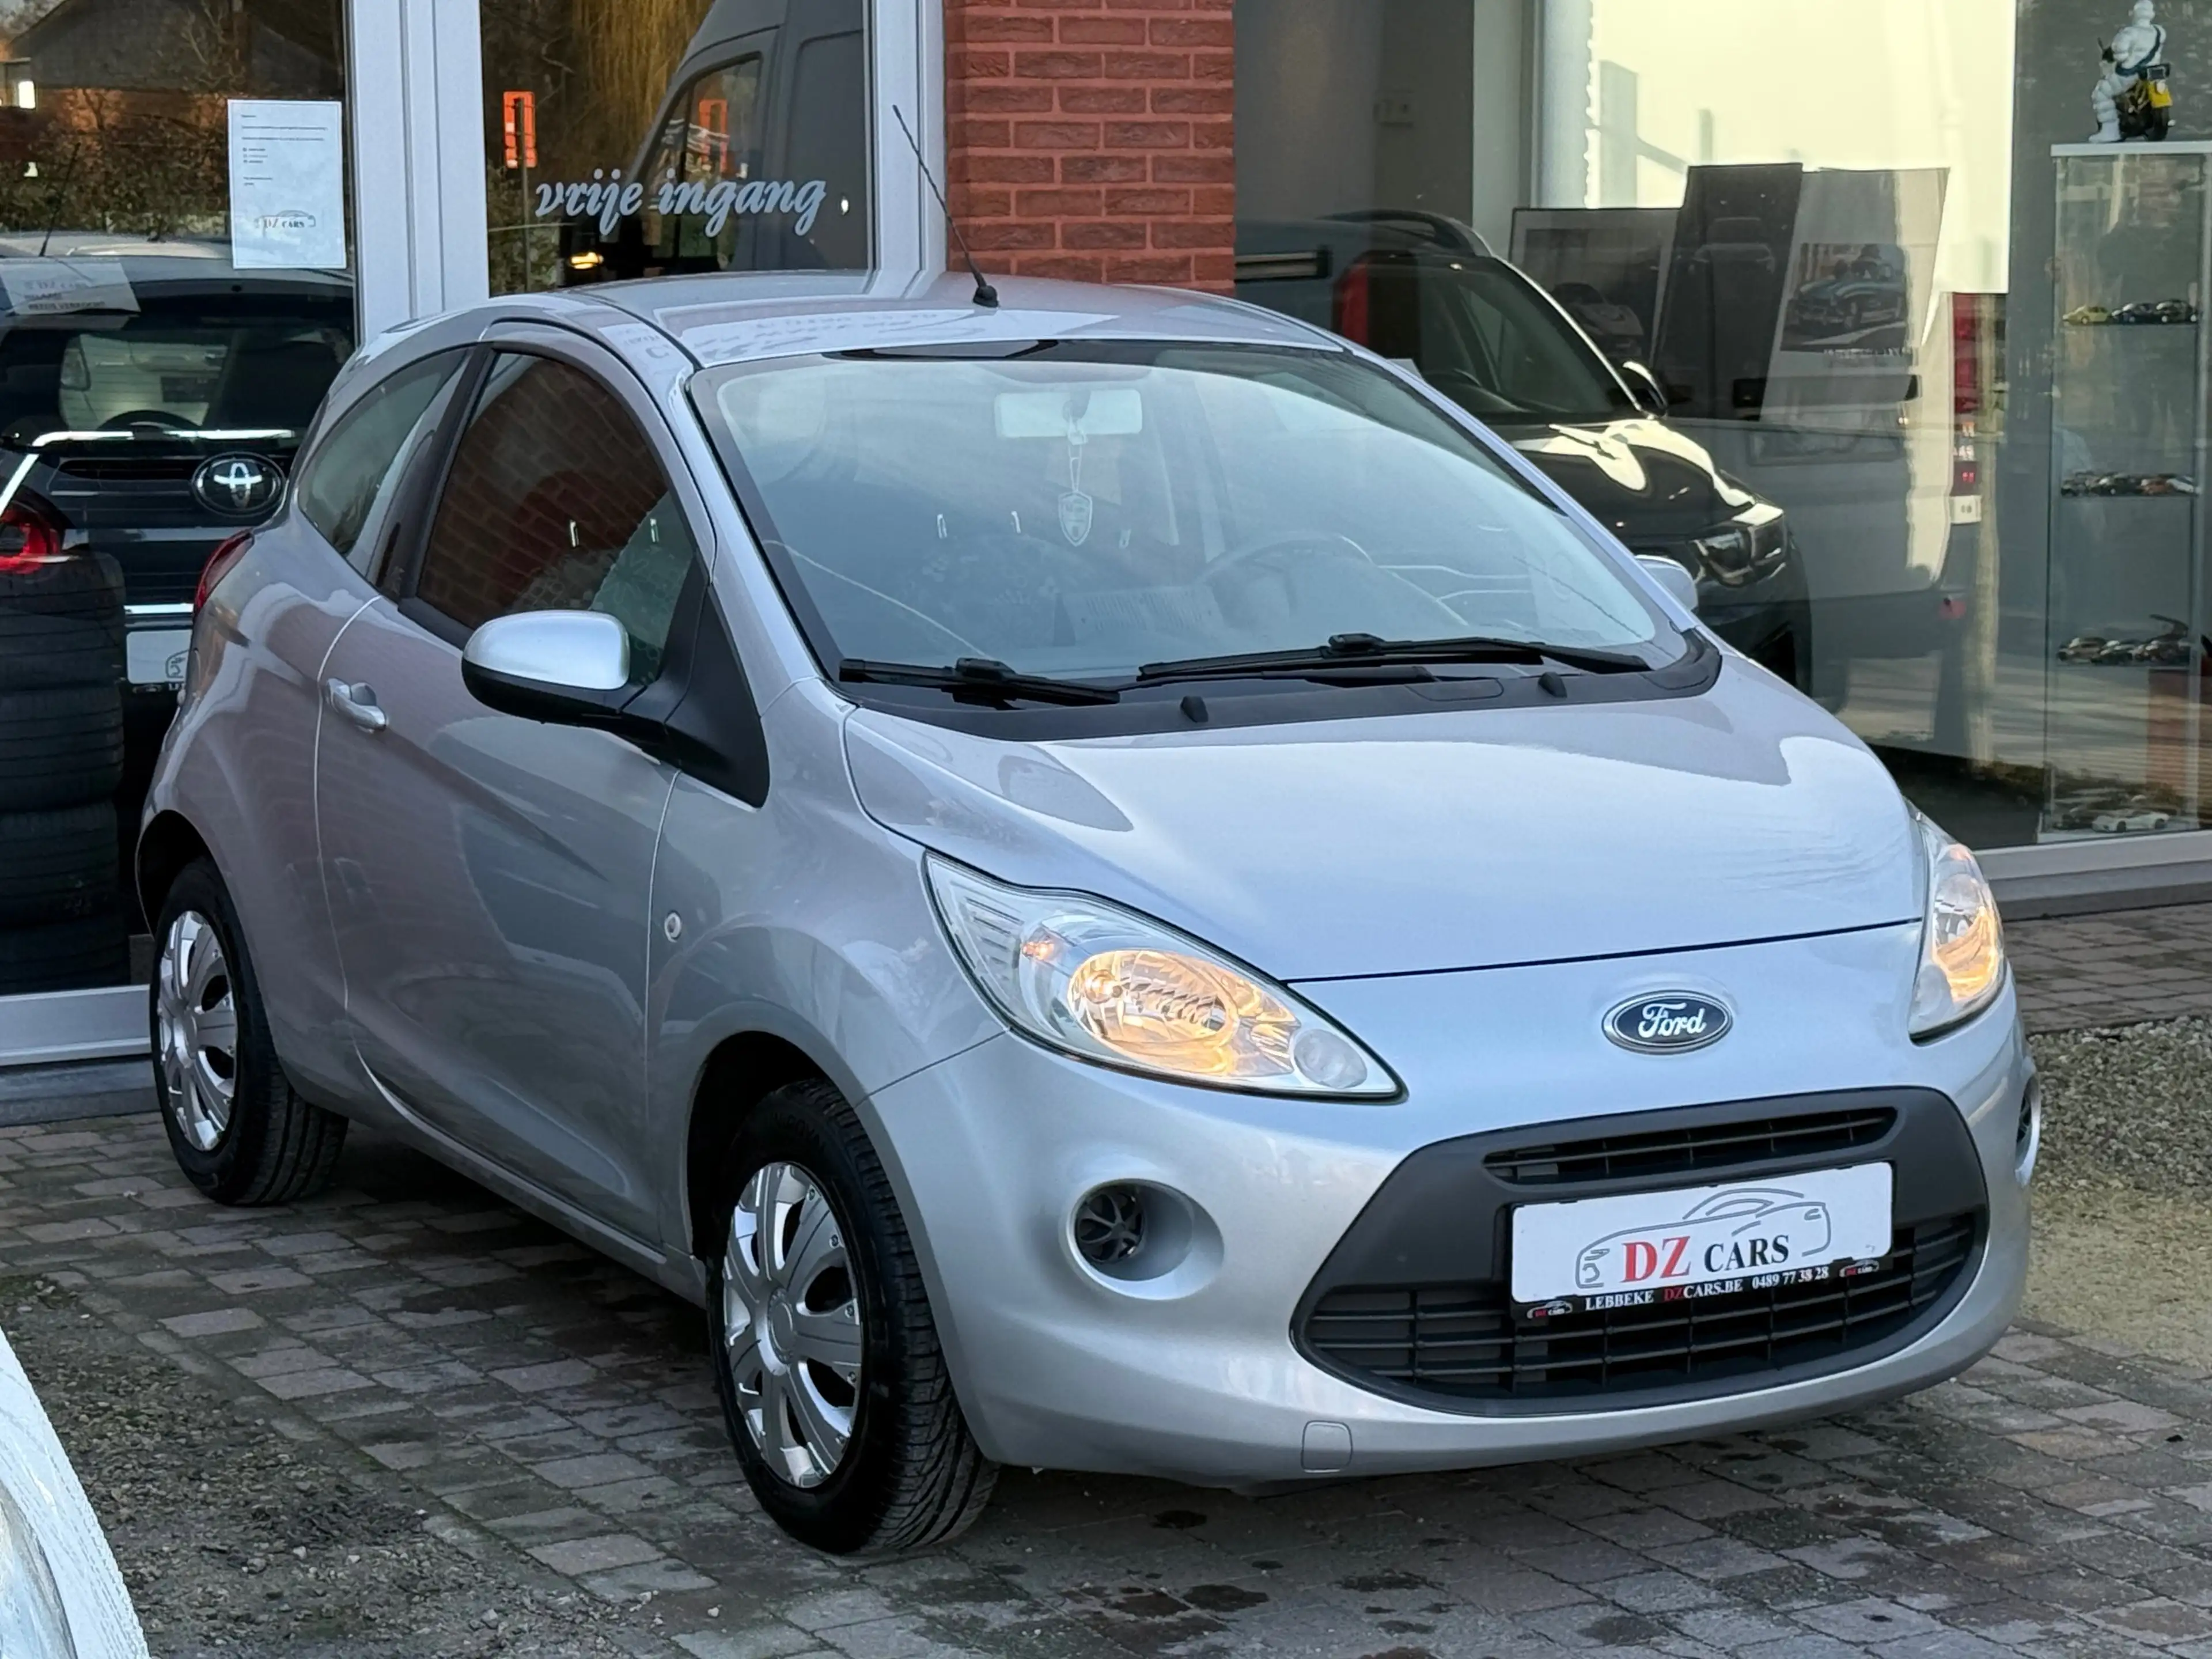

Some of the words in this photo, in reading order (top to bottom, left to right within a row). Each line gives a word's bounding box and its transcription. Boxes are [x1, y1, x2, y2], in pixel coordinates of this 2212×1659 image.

[535, 168, 643, 236] vrije
[658, 168, 827, 238] ingang
[1638, 1002, 1707, 1038] Ford
[1619, 1236, 1691, 1283] DZ
[1704, 1235, 1789, 1272] CARS
[1585, 1290, 1654, 1311] LEBBEKE
[1664, 1278, 1744, 1302] DZCARS.BE
[1752, 1273, 1780, 1290] 0489
[1782, 1270, 1796, 1285] 77
[1815, 1266, 1830, 1281] 28
